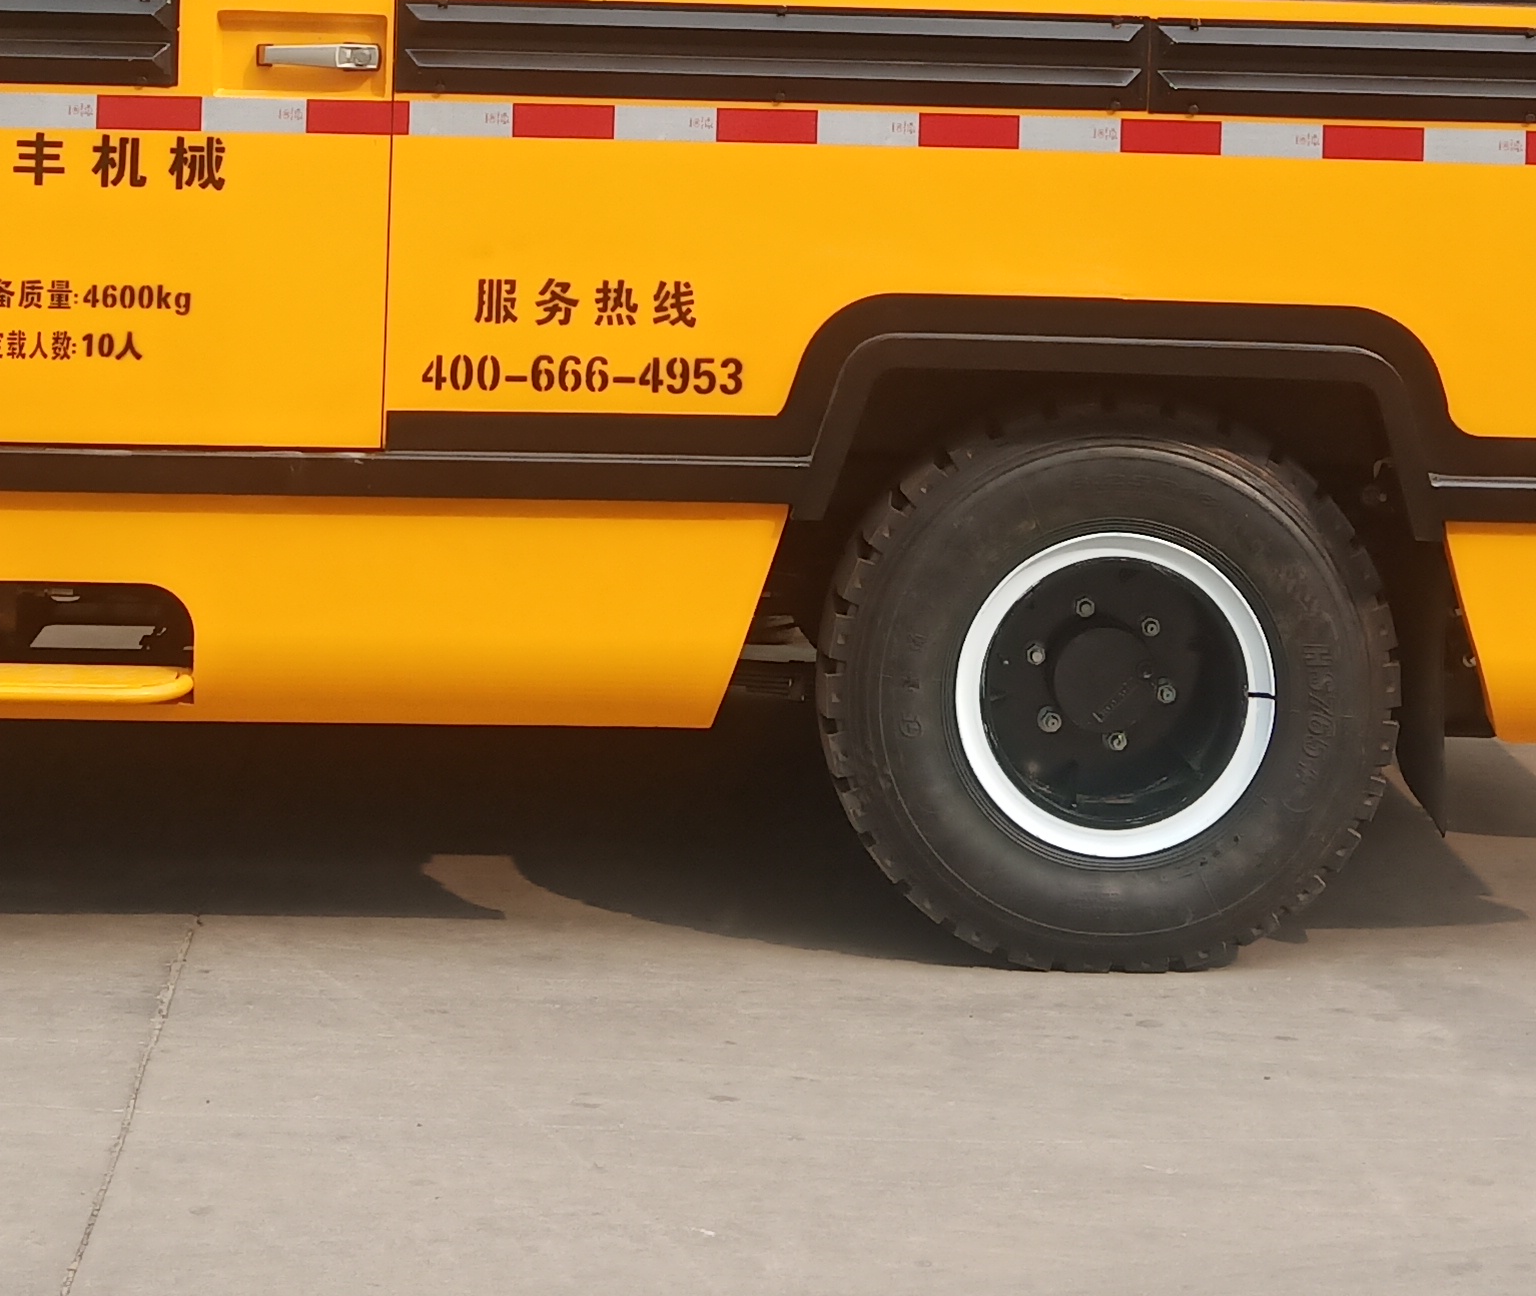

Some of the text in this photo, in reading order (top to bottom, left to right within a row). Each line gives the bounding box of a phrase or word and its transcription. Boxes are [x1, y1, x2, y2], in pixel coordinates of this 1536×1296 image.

[474, 278, 697, 328] 服务热线
[421, 354, 744, 396] 400-666-4953
